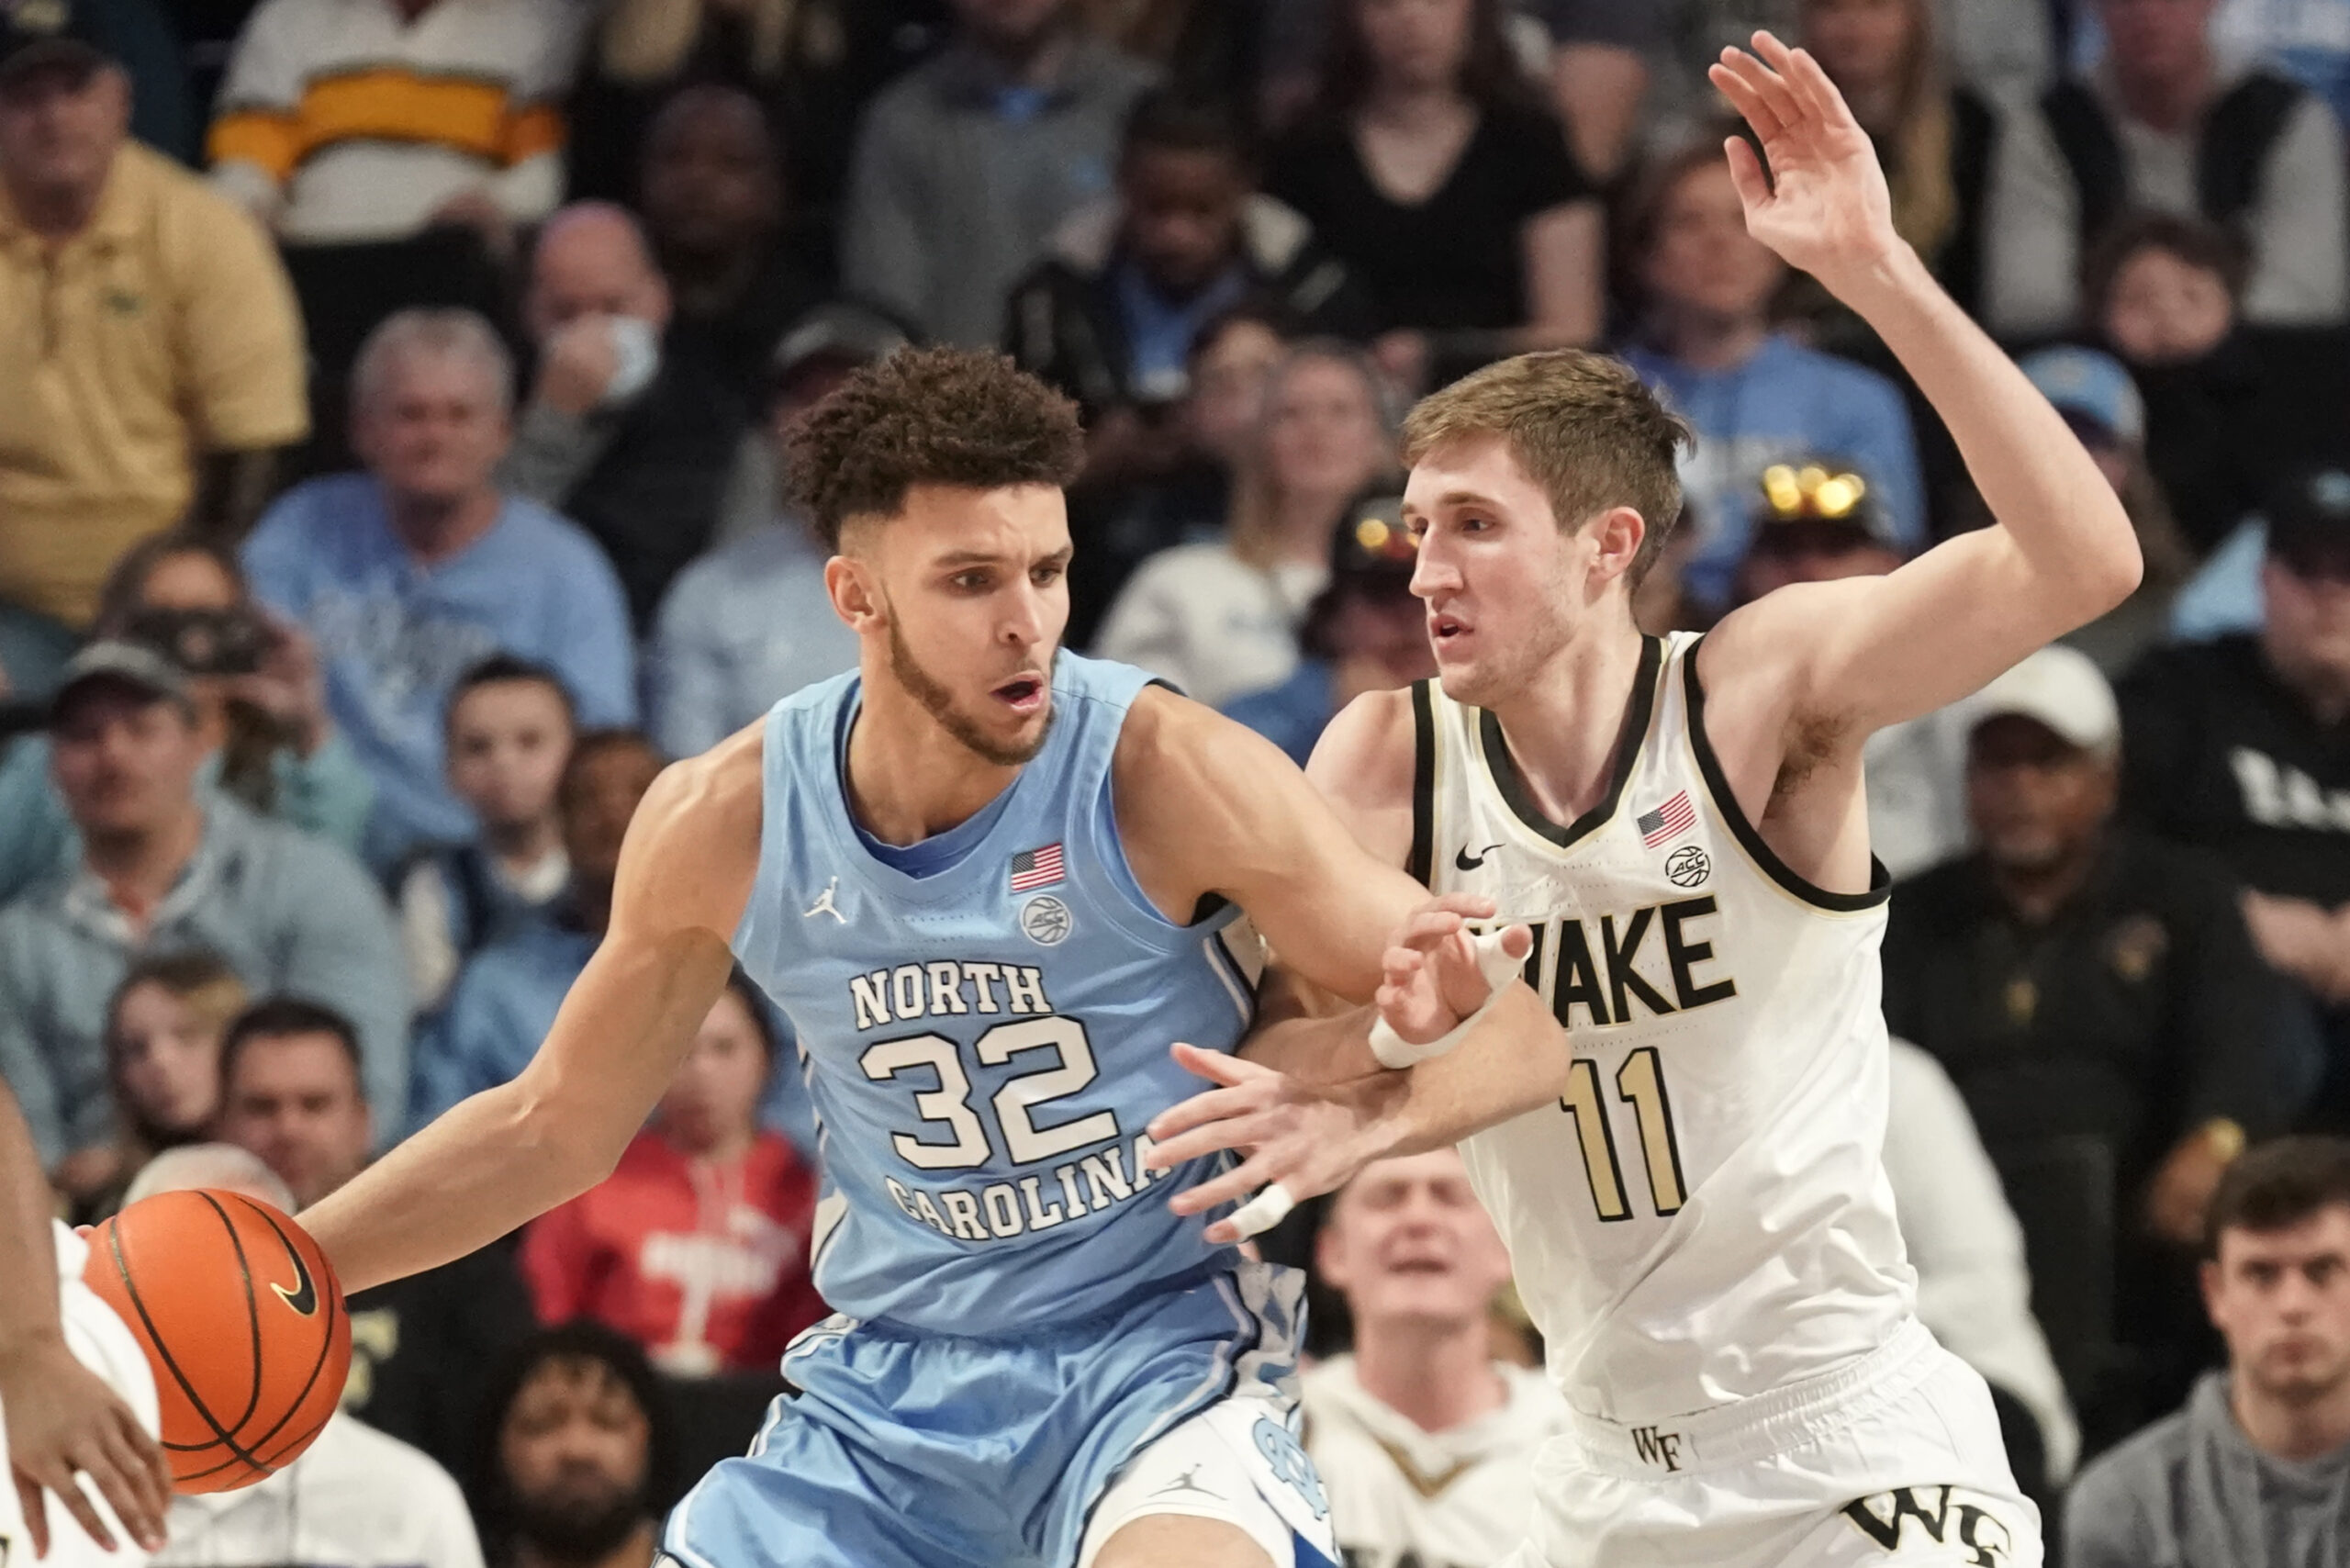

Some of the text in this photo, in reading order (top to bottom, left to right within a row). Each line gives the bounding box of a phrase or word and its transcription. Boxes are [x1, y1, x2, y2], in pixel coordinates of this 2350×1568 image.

[1673, 852, 1706, 874] ACC
[849, 960, 1054, 1030] NORTH
[858, 1015, 1119, 1170] 32
[1560, 1047, 1688, 1223] 11
[885, 1130, 1173, 1241] CAROLINA
[1630, 1426, 1683, 1473] WF
